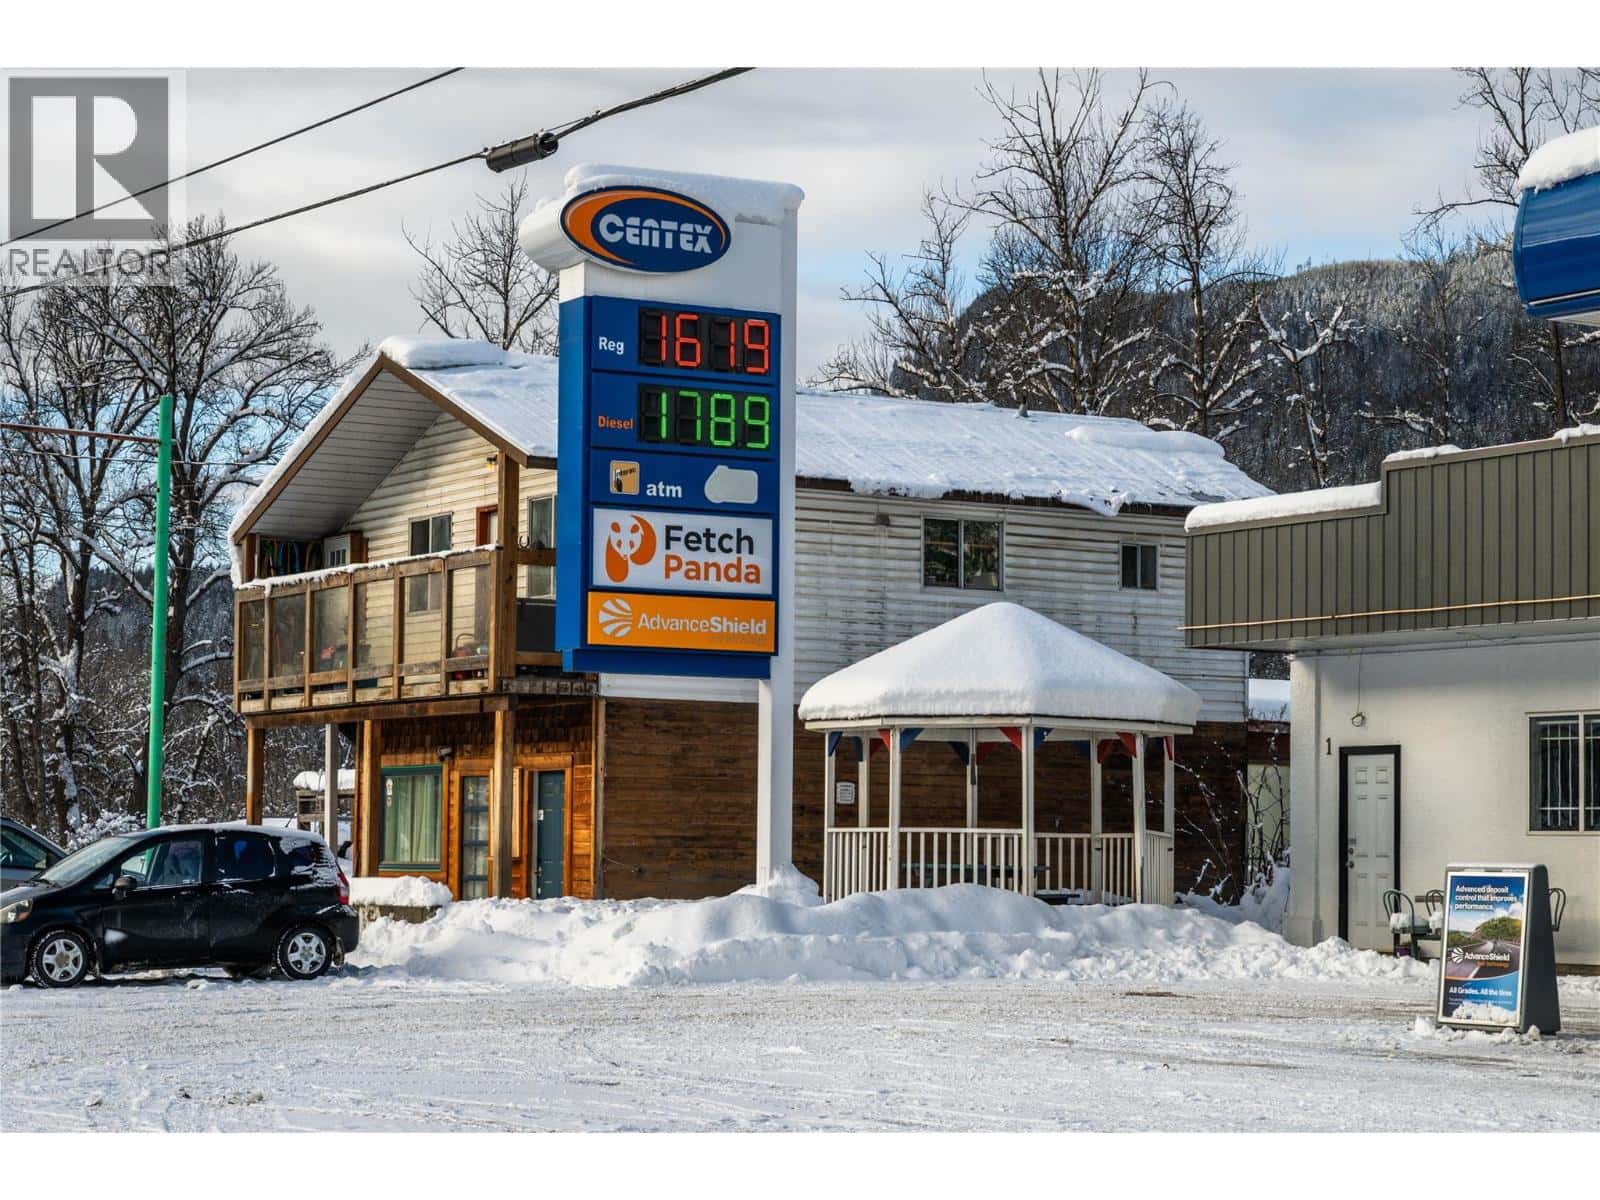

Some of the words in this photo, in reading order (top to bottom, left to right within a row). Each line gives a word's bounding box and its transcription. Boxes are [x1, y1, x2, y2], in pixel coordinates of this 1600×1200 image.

[599, 213, 713, 254] CENTEX
[599, 336, 625, 355] Reg
[597, 415, 634, 430] Diesel
[646, 481, 683, 498] atm
[664, 525, 754, 555] Fetch
[664, 554, 761, 584] Panda
[638, 612, 767, 635] AdvanceShield
[1326, 737, 1332, 755] 1
[1455, 885, 1485, 893] Advanced
[1487, 885, 1509, 895] deposit
[1464, 952, 1511, 961] AdvanceShield
